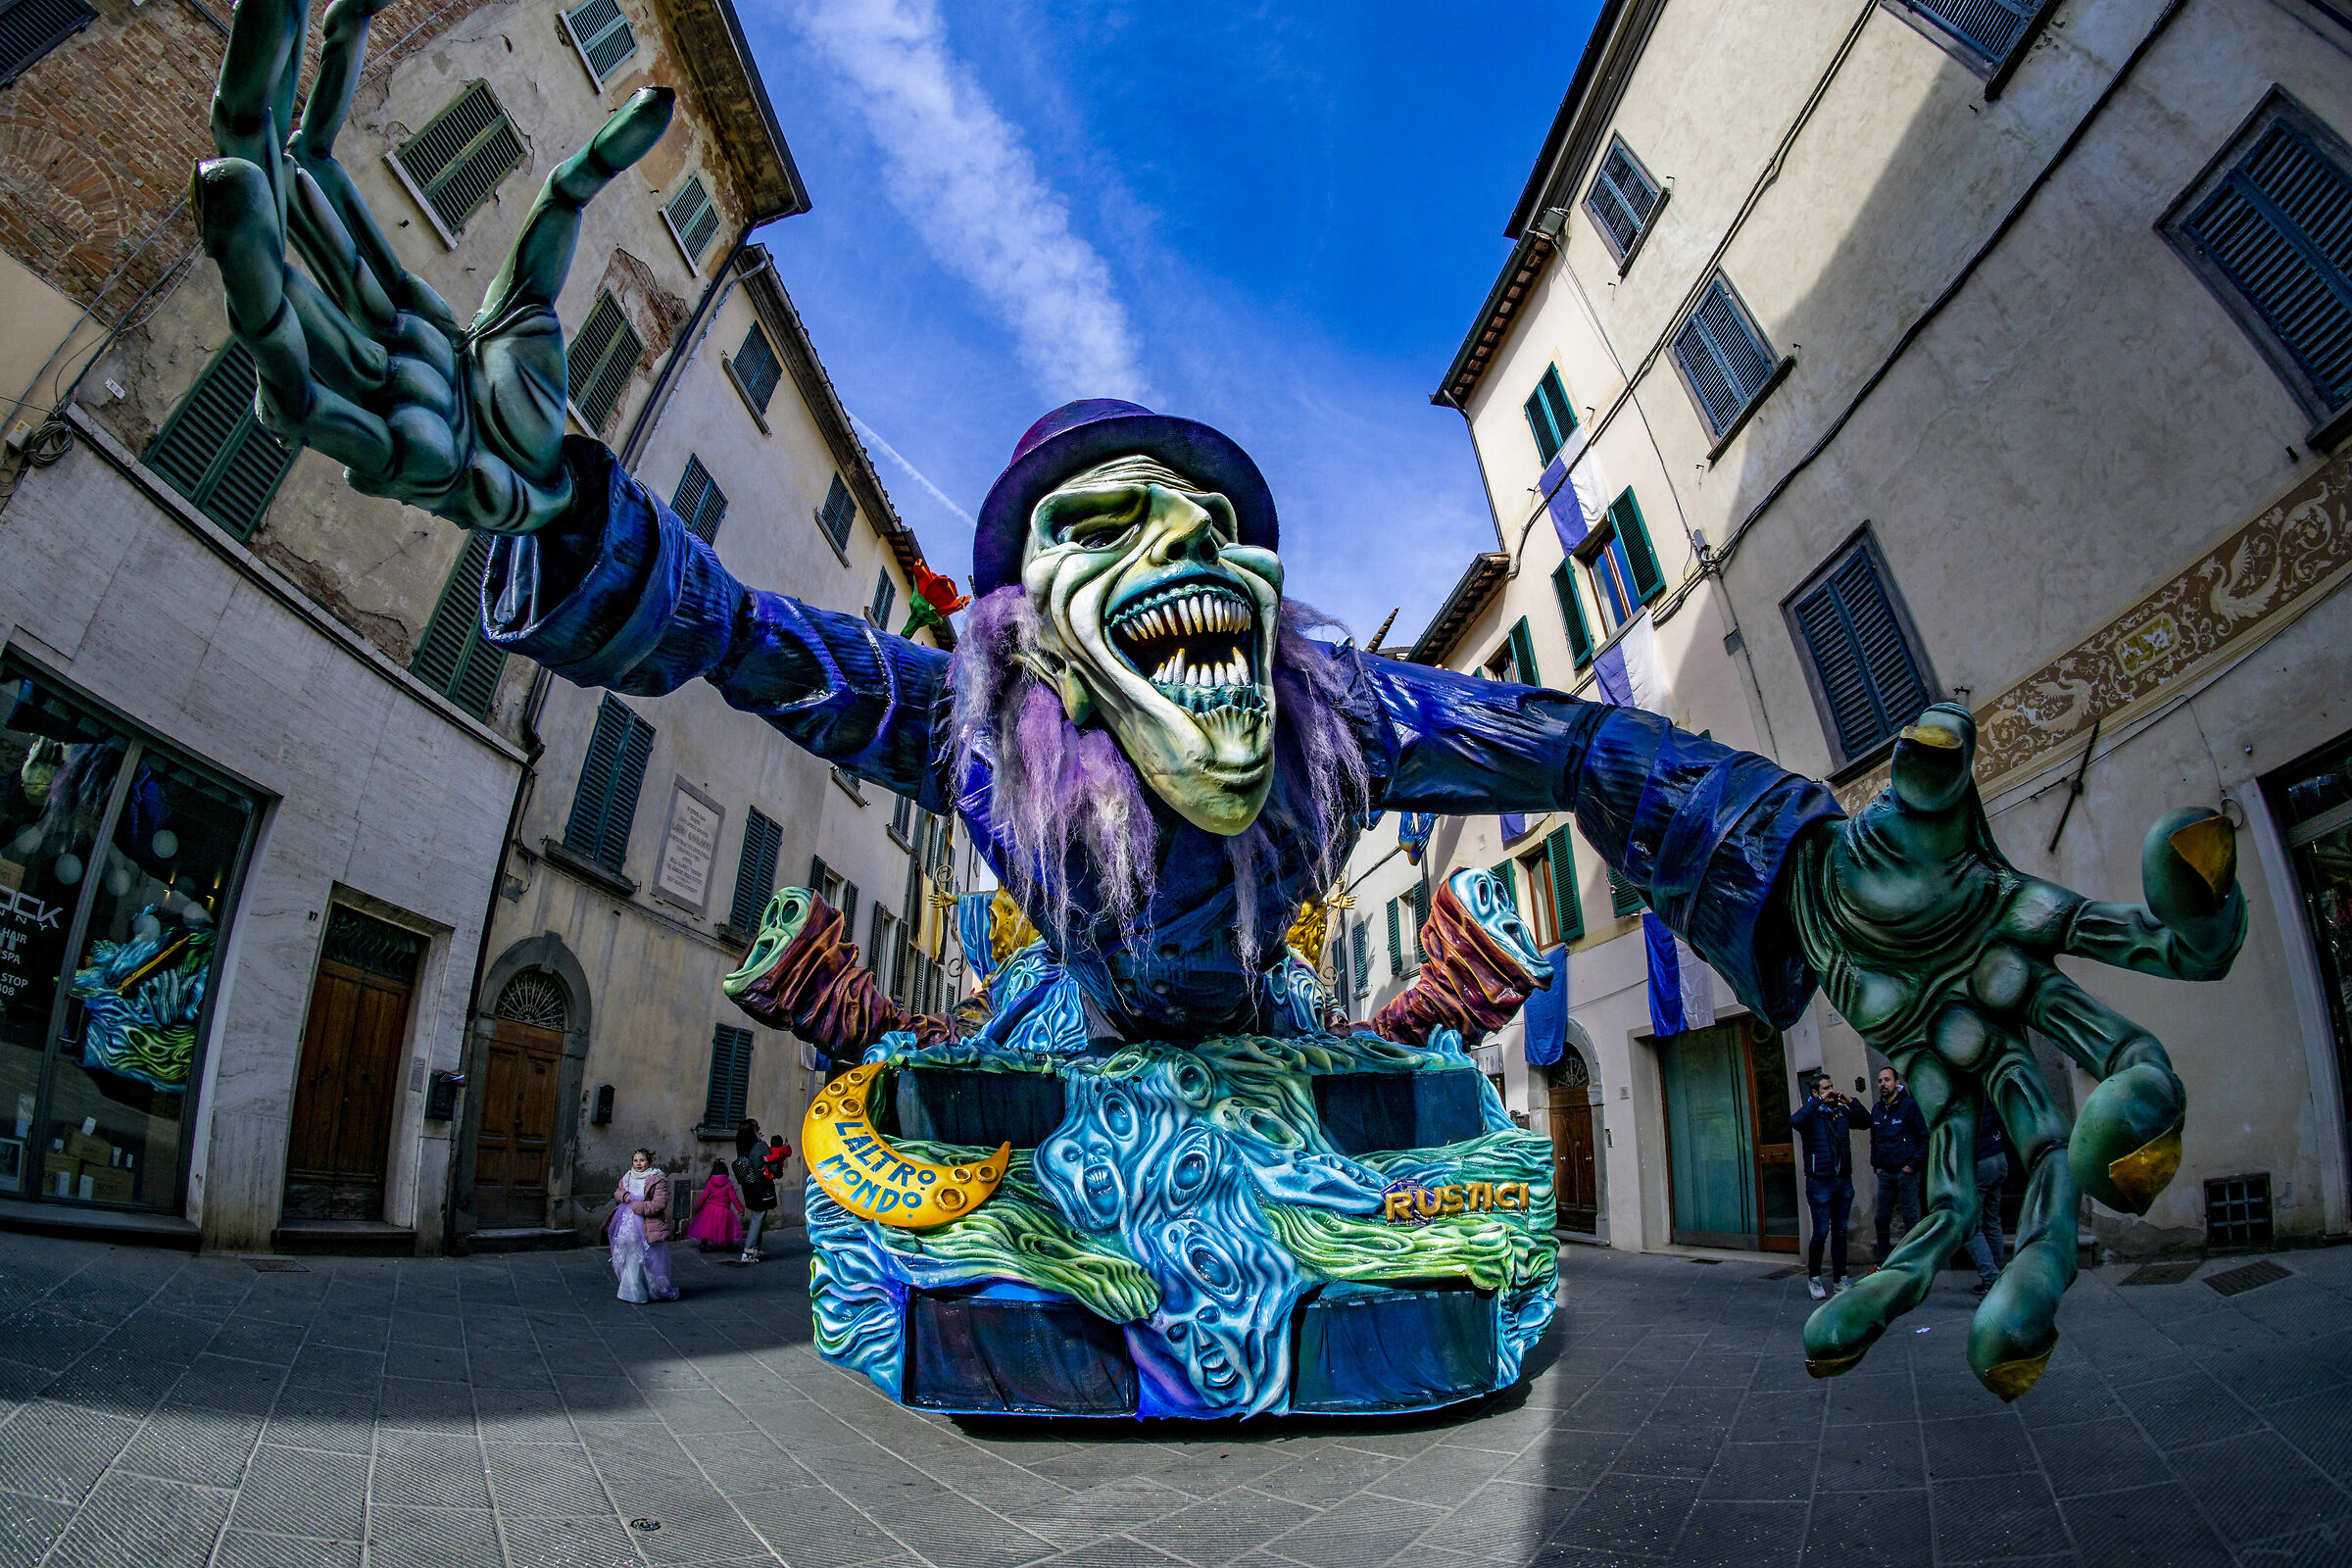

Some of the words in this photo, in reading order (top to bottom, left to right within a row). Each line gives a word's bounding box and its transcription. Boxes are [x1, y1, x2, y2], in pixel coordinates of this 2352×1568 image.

[2, 927, 27, 944] HAIR
[1, 950, 21, 964] SPA
[1, 972, 28, 988] STOP
[835, 1122, 937, 1188] L'ALTRO
[815, 1153, 923, 1215] MONDO
[1385, 1182, 1530, 1222] RUSTICI
